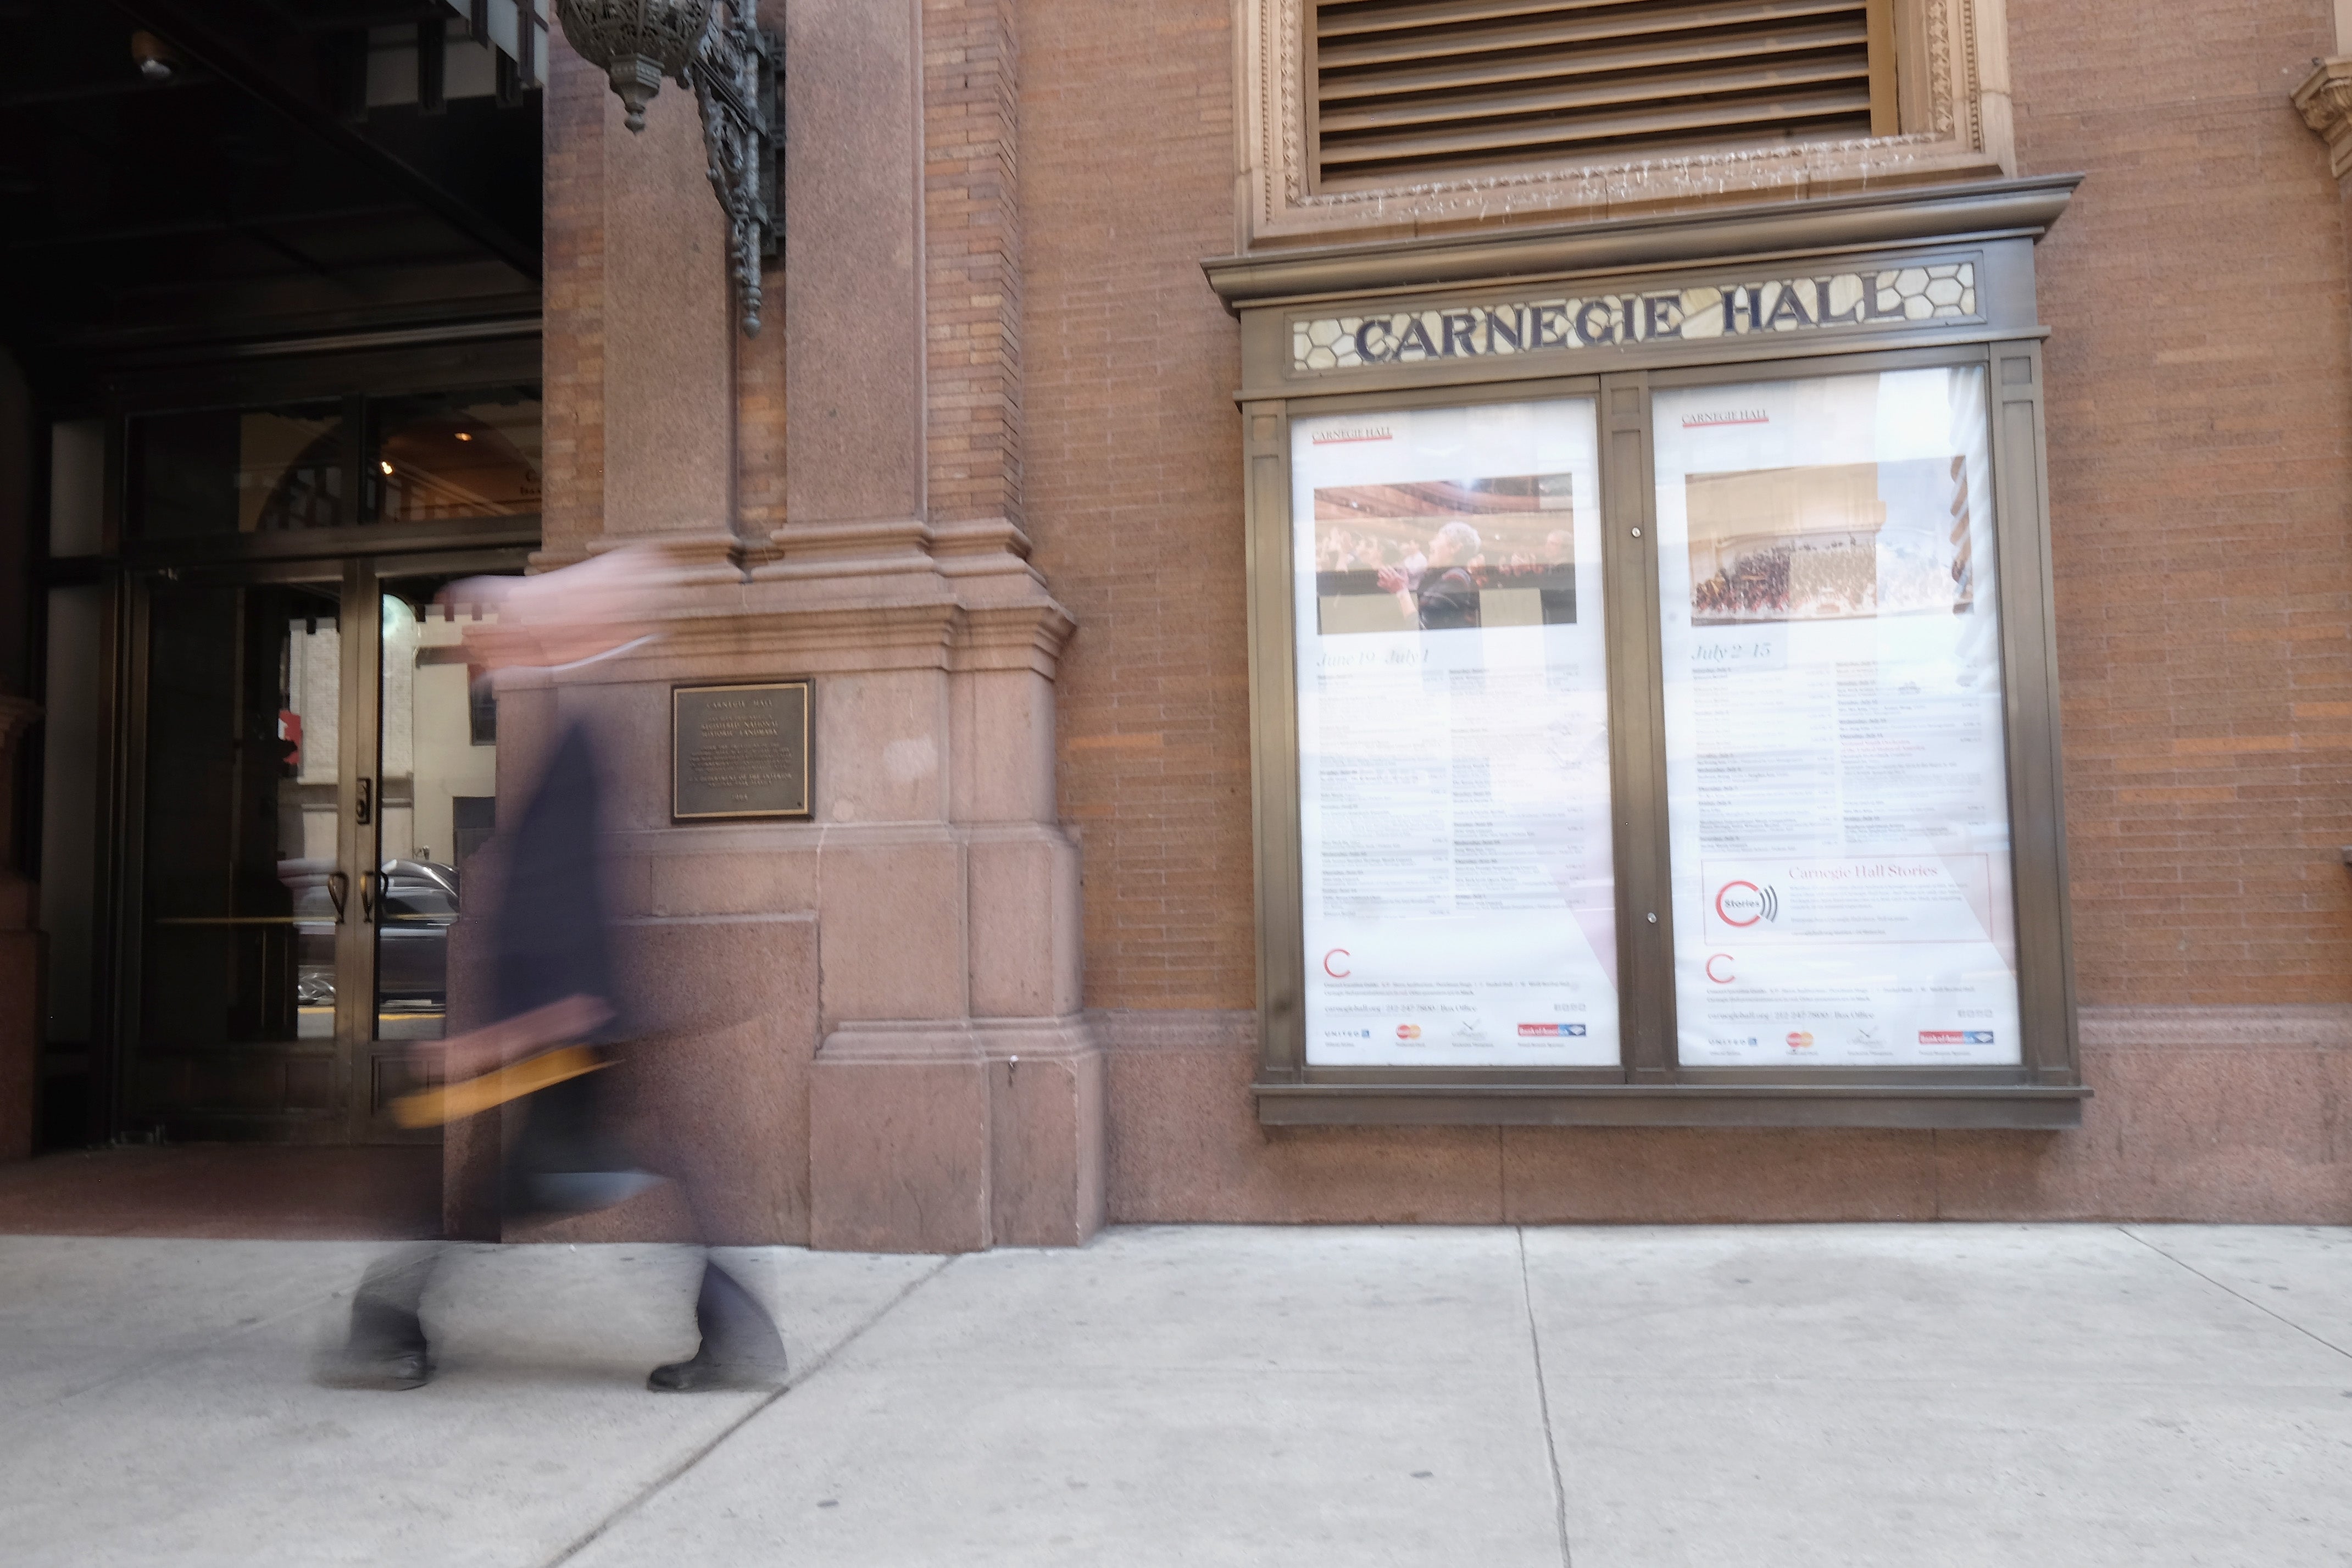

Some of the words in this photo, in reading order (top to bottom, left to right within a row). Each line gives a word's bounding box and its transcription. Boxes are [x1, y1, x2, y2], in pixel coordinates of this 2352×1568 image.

[1355, 295, 1681, 363] CARNEGIE
[1723, 275, 1905, 331] HALL
[1682, 410, 1737, 423] CARNEGIE
[1741, 409, 1767, 420] HALL
[1313, 429, 1361, 440] CARNEGIE
[1366, 426, 1390, 437] HALL
[1692, 644, 1728, 663] July
[1789, 866, 1851, 880] Carnegie
[1855, 865, 1884, 878] Hall
[1888, 864, 1938, 878] Stories
[1725, 899, 1760, 908] Stories
